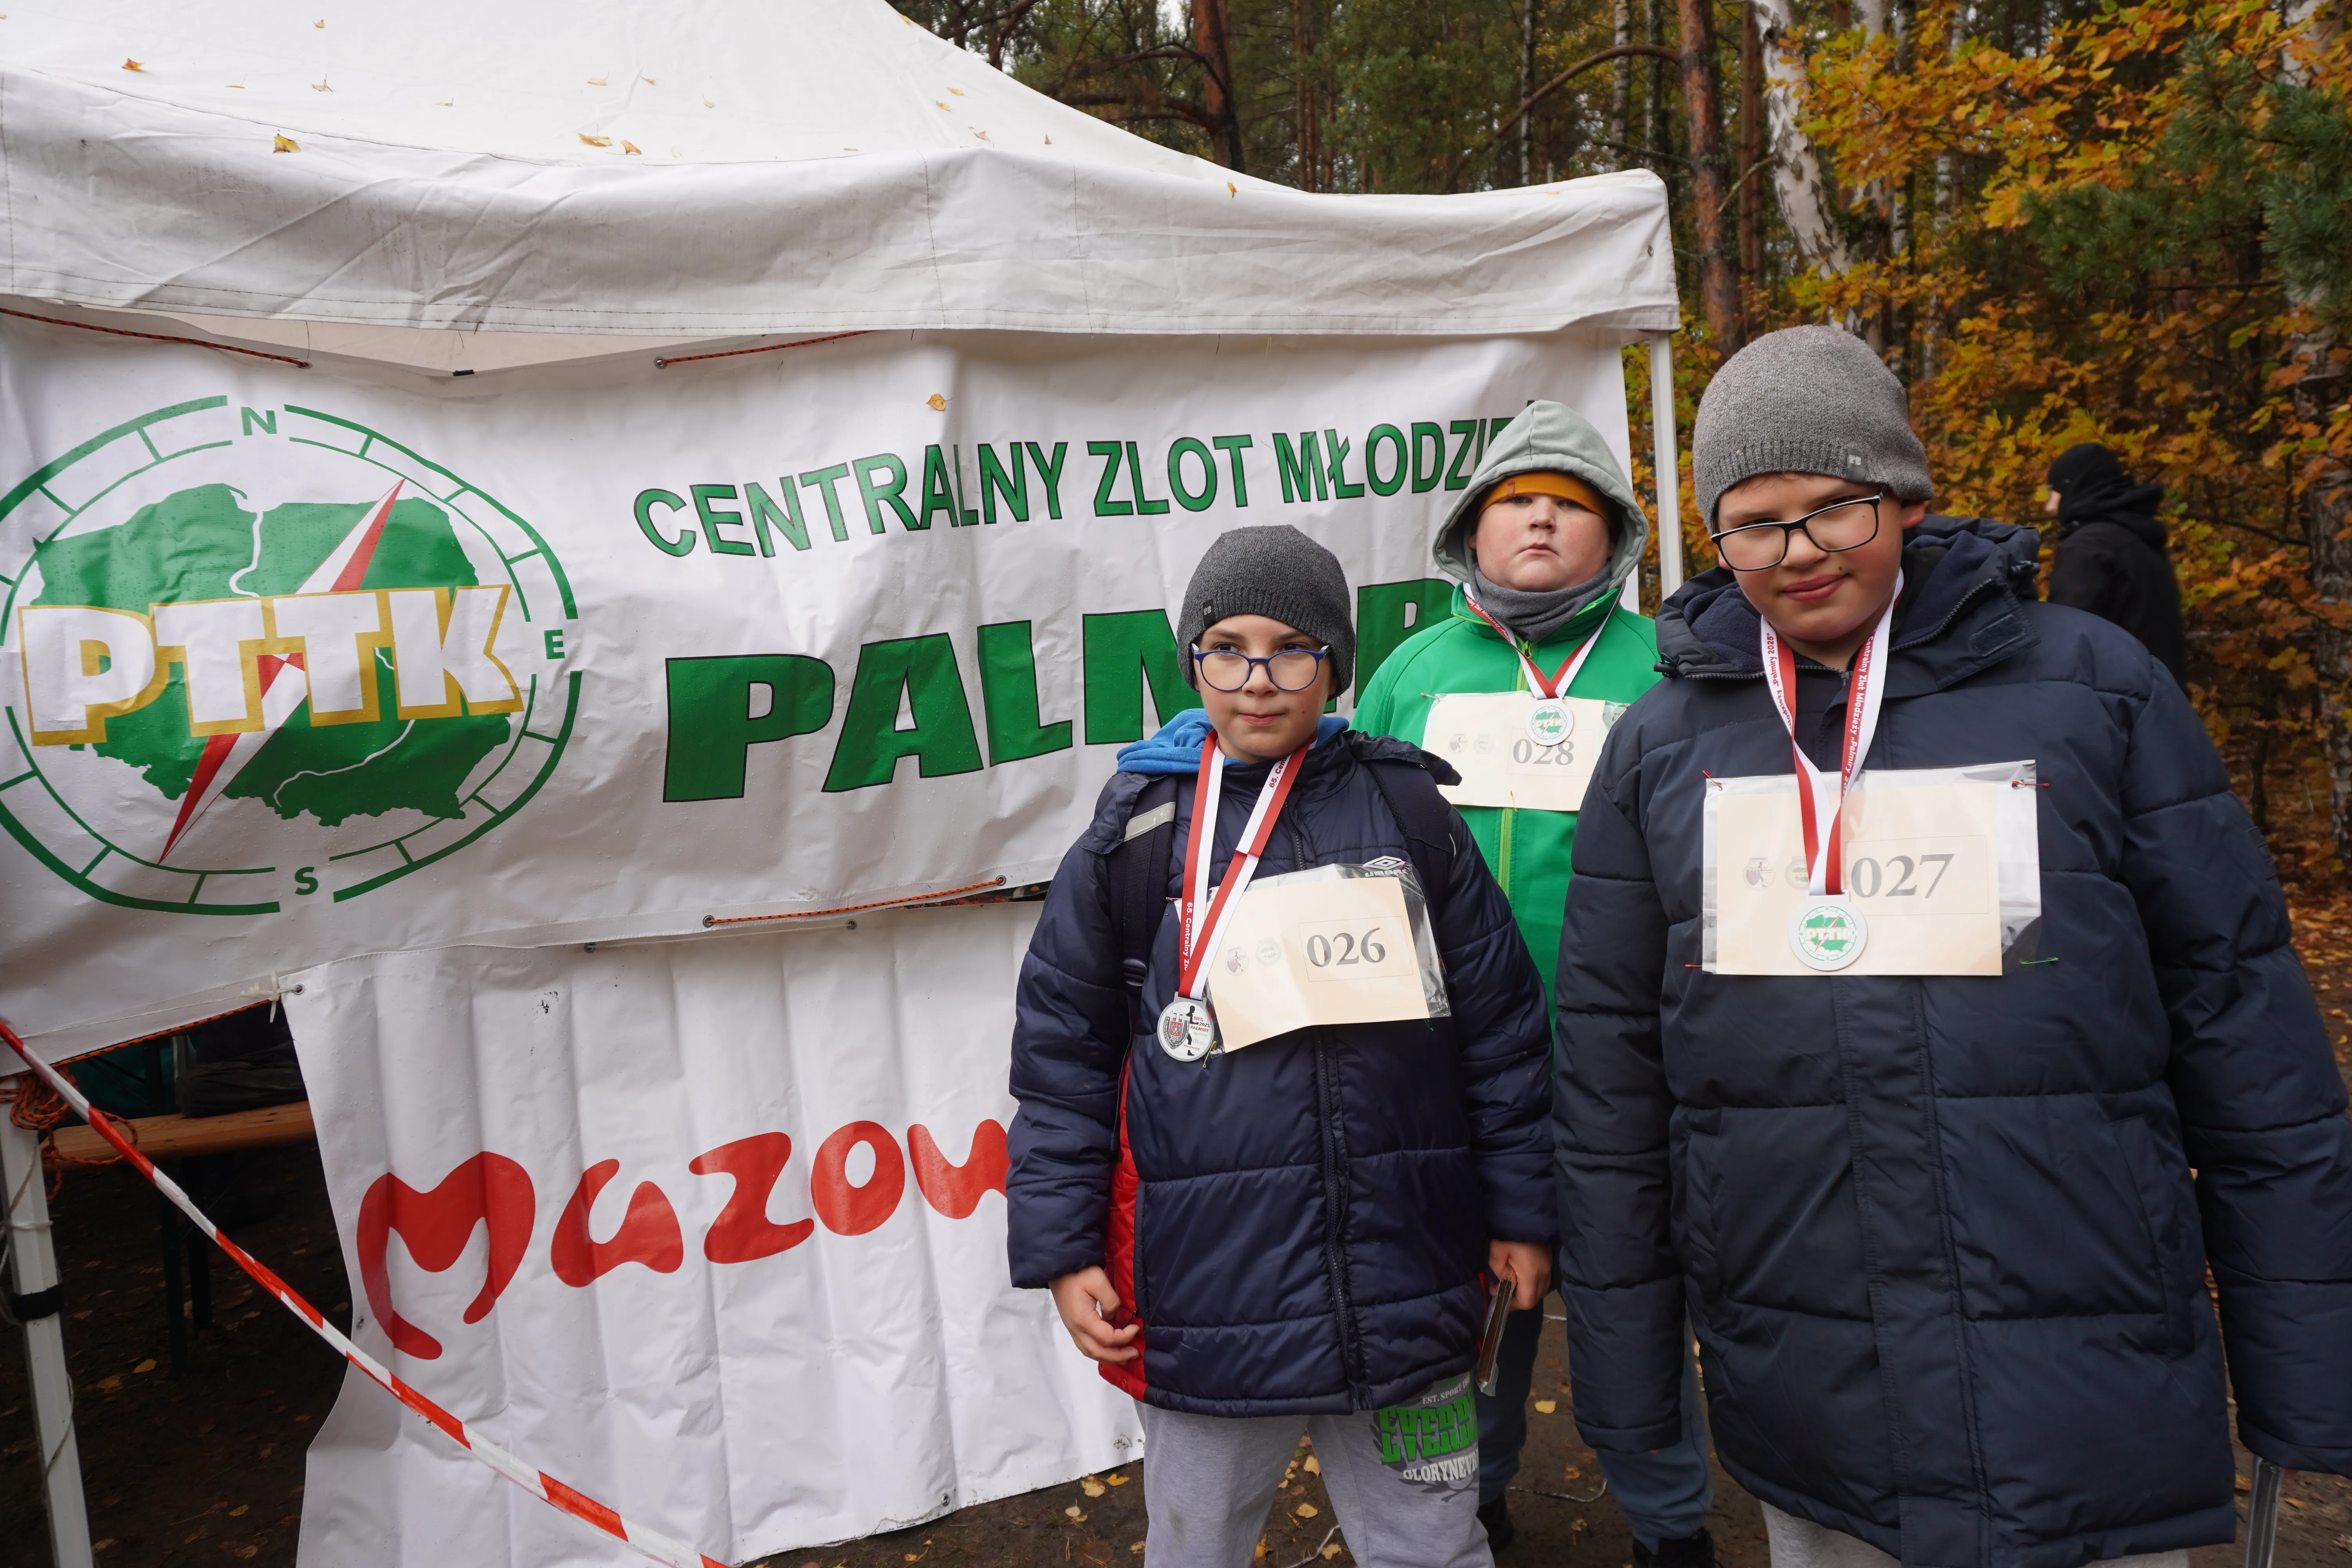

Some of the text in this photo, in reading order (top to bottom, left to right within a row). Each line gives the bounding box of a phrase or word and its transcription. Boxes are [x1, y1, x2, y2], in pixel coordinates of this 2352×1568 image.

[242, 407, 278, 436] N
[633, 400, 1534, 558] CENTRALNY ZLOT MŁODZI
[544, 630, 565, 659] E
[1859, 636, 1873, 672] Centralny
[18, 584, 524, 746] PTTK
[1857, 675, 1867, 690] Zlot
[1513, 739, 1575, 766] 028
[1269, 777, 1278, 788] 65.
[294, 867, 319, 895] S
[1851, 854, 1955, 898] 027
[1183, 918, 1192, 956] Centralny
[1307, 928, 1386, 967] 026
[1806, 927, 1849, 941] PTTK
[357, 1119, 1007, 1360] Mazow
[1441, 1383, 1462, 1400] SPORT
